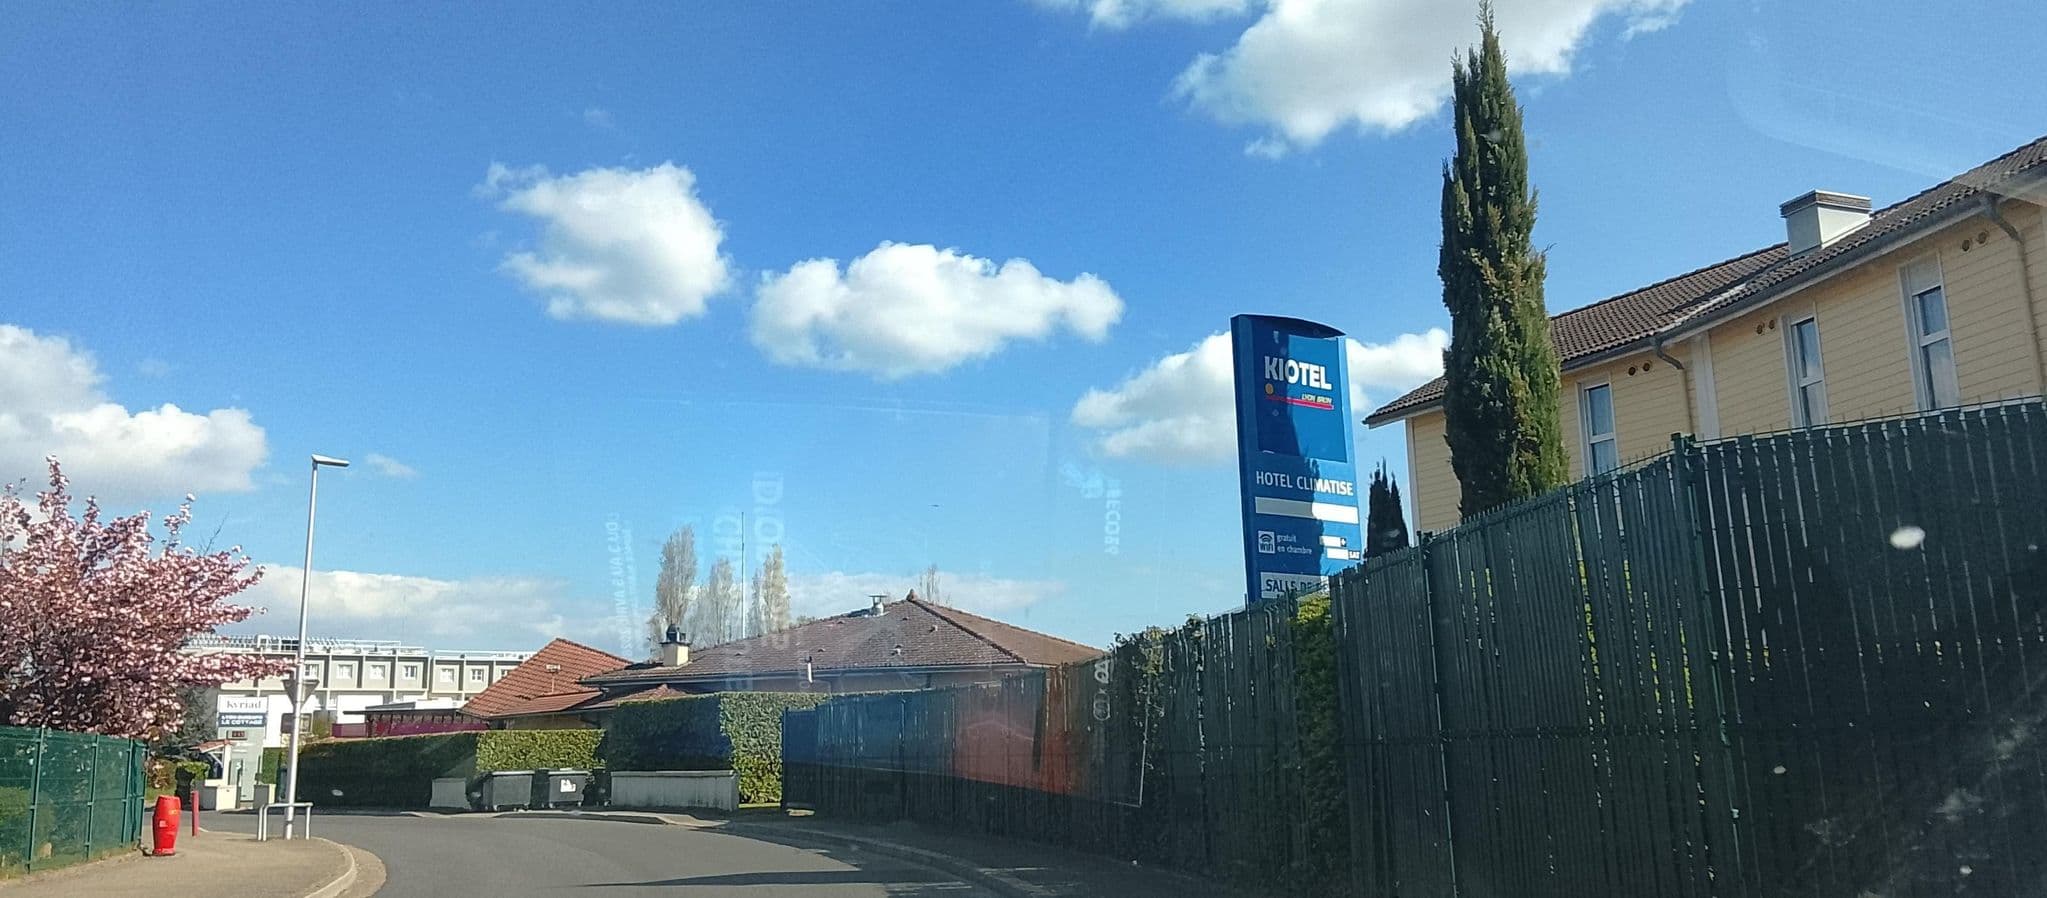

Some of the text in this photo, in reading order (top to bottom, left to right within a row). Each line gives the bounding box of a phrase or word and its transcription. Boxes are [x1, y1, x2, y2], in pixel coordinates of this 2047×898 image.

[1264, 356, 1332, 390] KIOTEL
[1256, 471, 1354, 496] HOTEL CLIMATISE
[1287, 546, 1312, 554] chambre
[227, 701, 262, 711] kyriad
